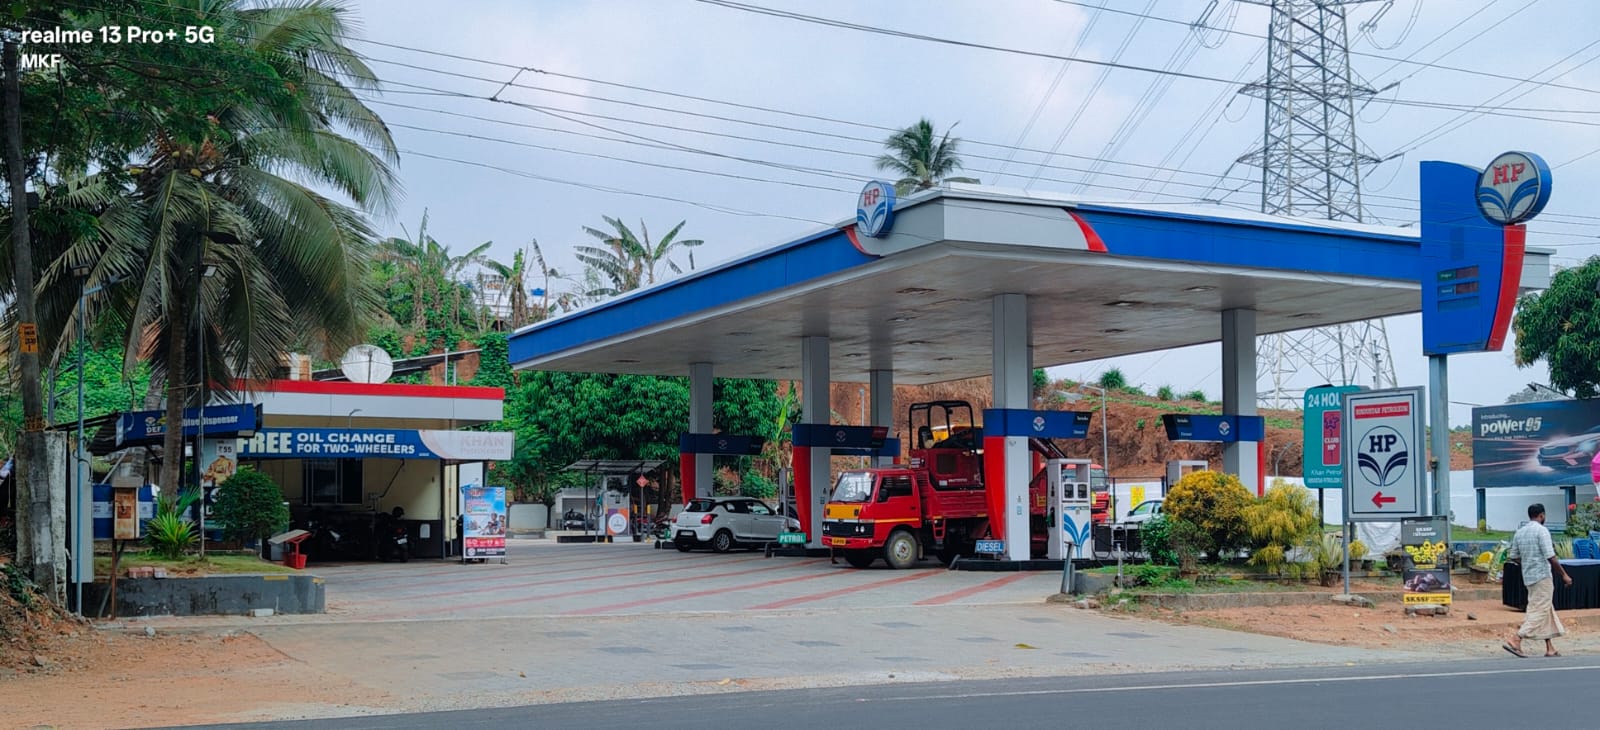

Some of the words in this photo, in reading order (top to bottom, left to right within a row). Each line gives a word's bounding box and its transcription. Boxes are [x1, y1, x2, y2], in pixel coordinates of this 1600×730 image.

[1492, 163, 1525, 185] HP
[864, 188, 879, 207] HP
[1308, 394, 1319, 408] 24
[1525, 417, 1542, 431] 95
[236, 432, 292, 454] FREE
[297, 433, 324, 443] OIL
[328, 434, 395, 443] CHANGE
[1369, 434, 1397, 453] HP
[297, 444, 320, 453] FOR
[323, 444, 415, 454] TWO-WHEELERS
[977, 542, 1002, 551] DIESEL
